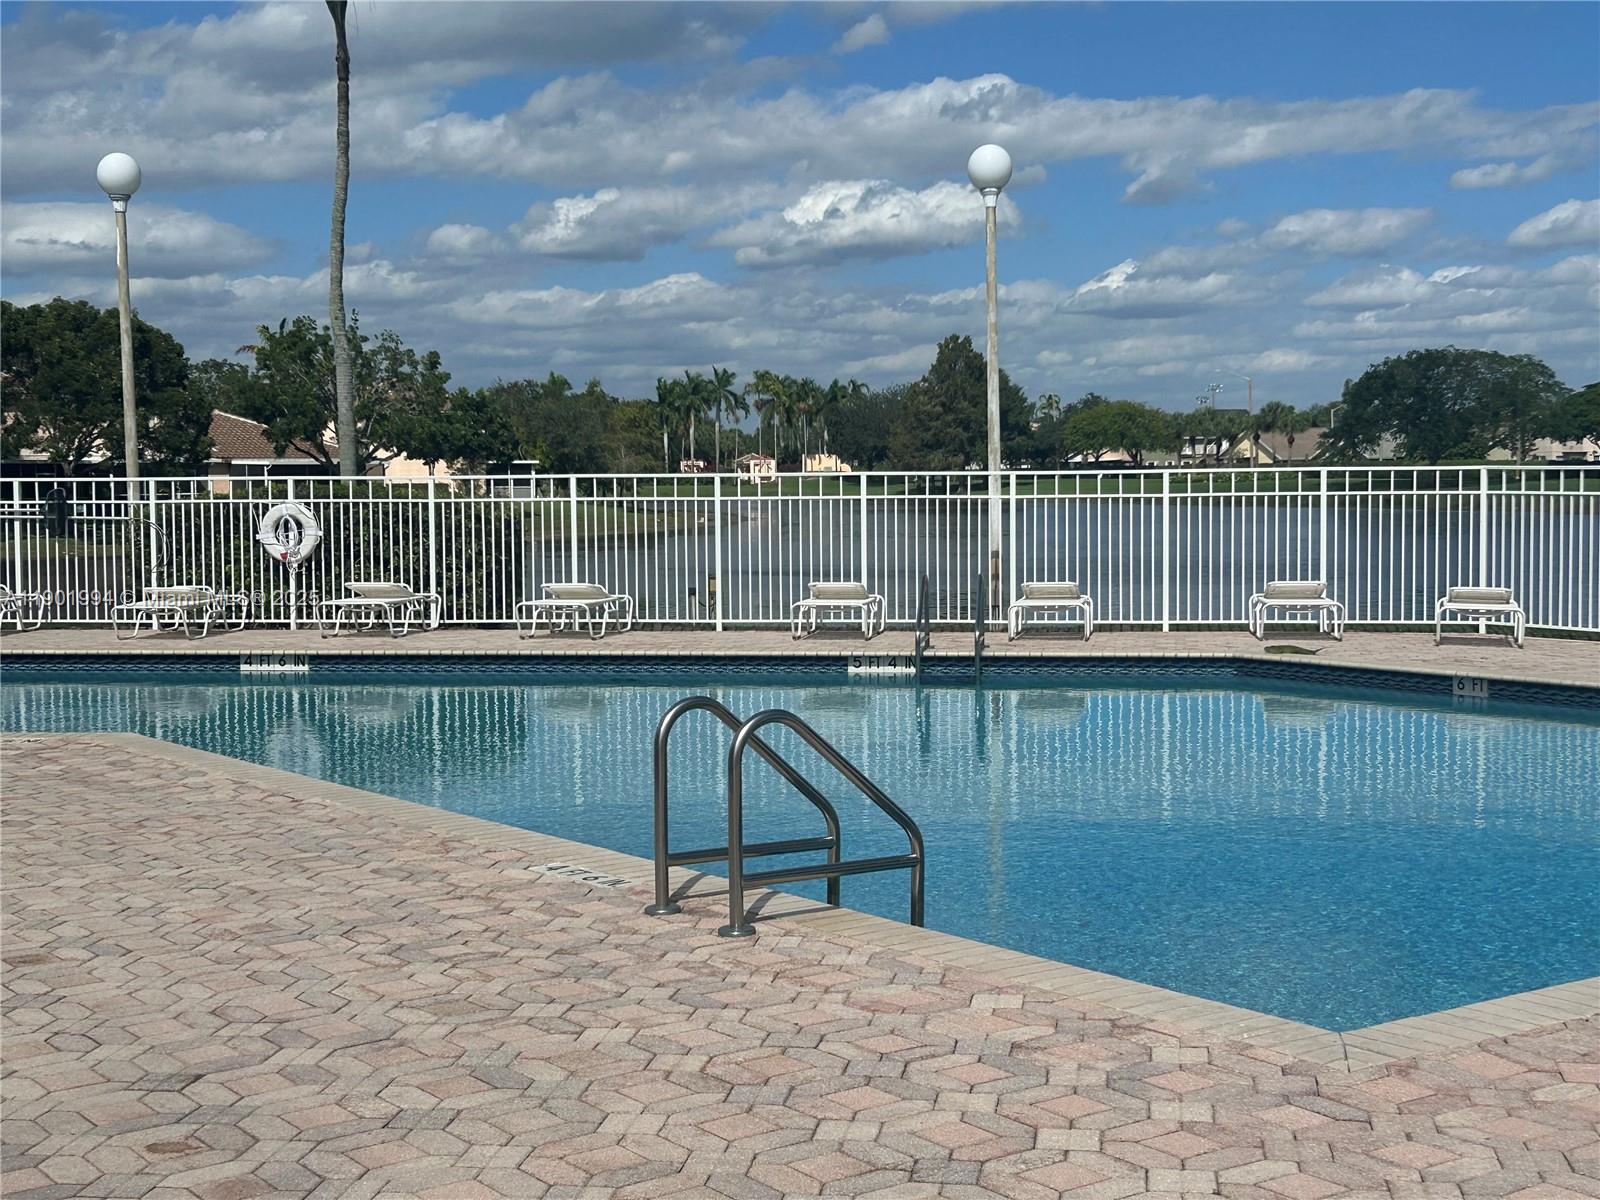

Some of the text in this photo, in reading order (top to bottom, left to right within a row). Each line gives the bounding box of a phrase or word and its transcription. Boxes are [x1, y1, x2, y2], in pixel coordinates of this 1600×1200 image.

[244, 655, 306, 667] 4 FT 6 IN
[853, 657, 862, 669] 5
[869, 657, 881, 669] FT
[888, 657, 897, 669] 4
[1457, 677, 1465, 690] 6
